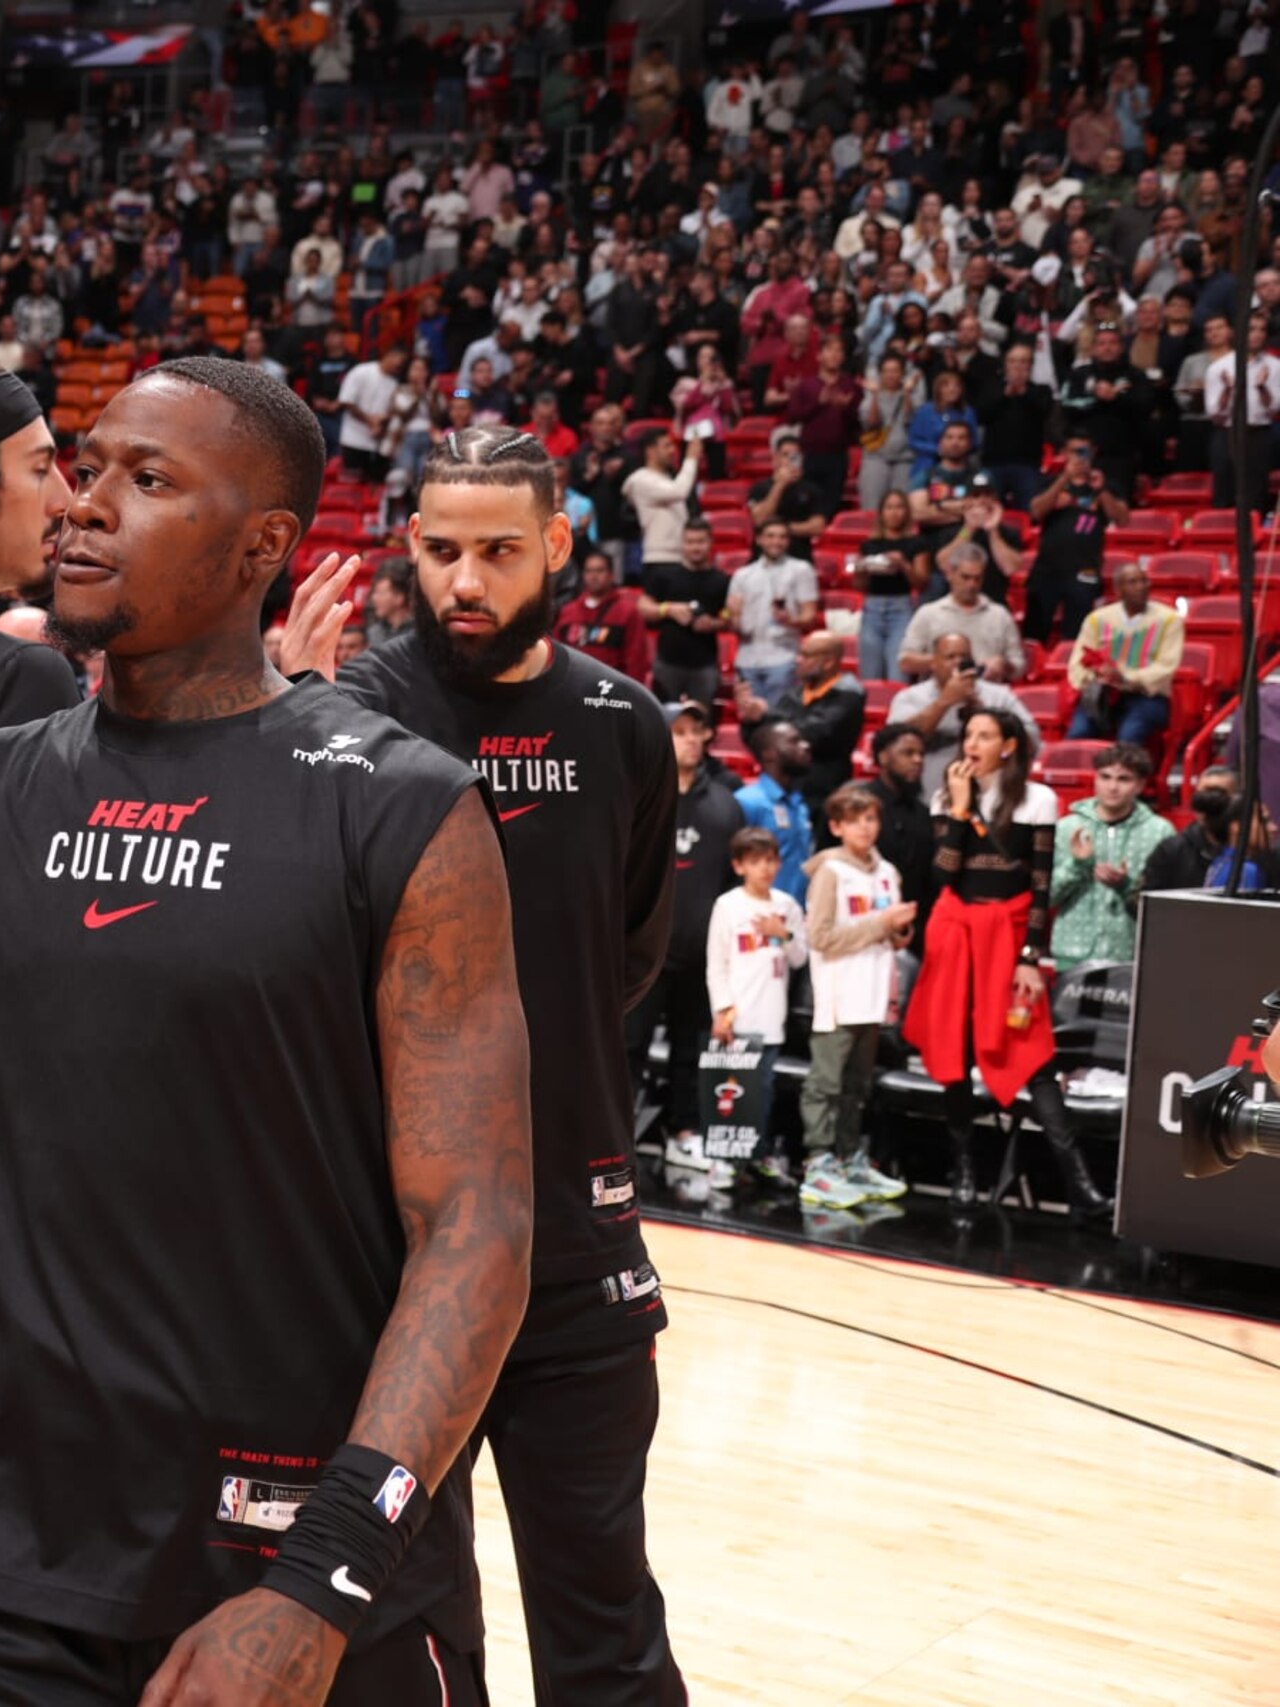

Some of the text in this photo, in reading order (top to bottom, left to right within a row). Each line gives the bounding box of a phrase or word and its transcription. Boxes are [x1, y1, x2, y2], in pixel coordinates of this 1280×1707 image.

[583, 695, 632, 711] mph.com
[478, 730, 555, 756] HEAT
[292, 747, 375, 774] mph.com
[86, 796, 209, 832] HEAT
[44, 831, 231, 890] CULTURE
